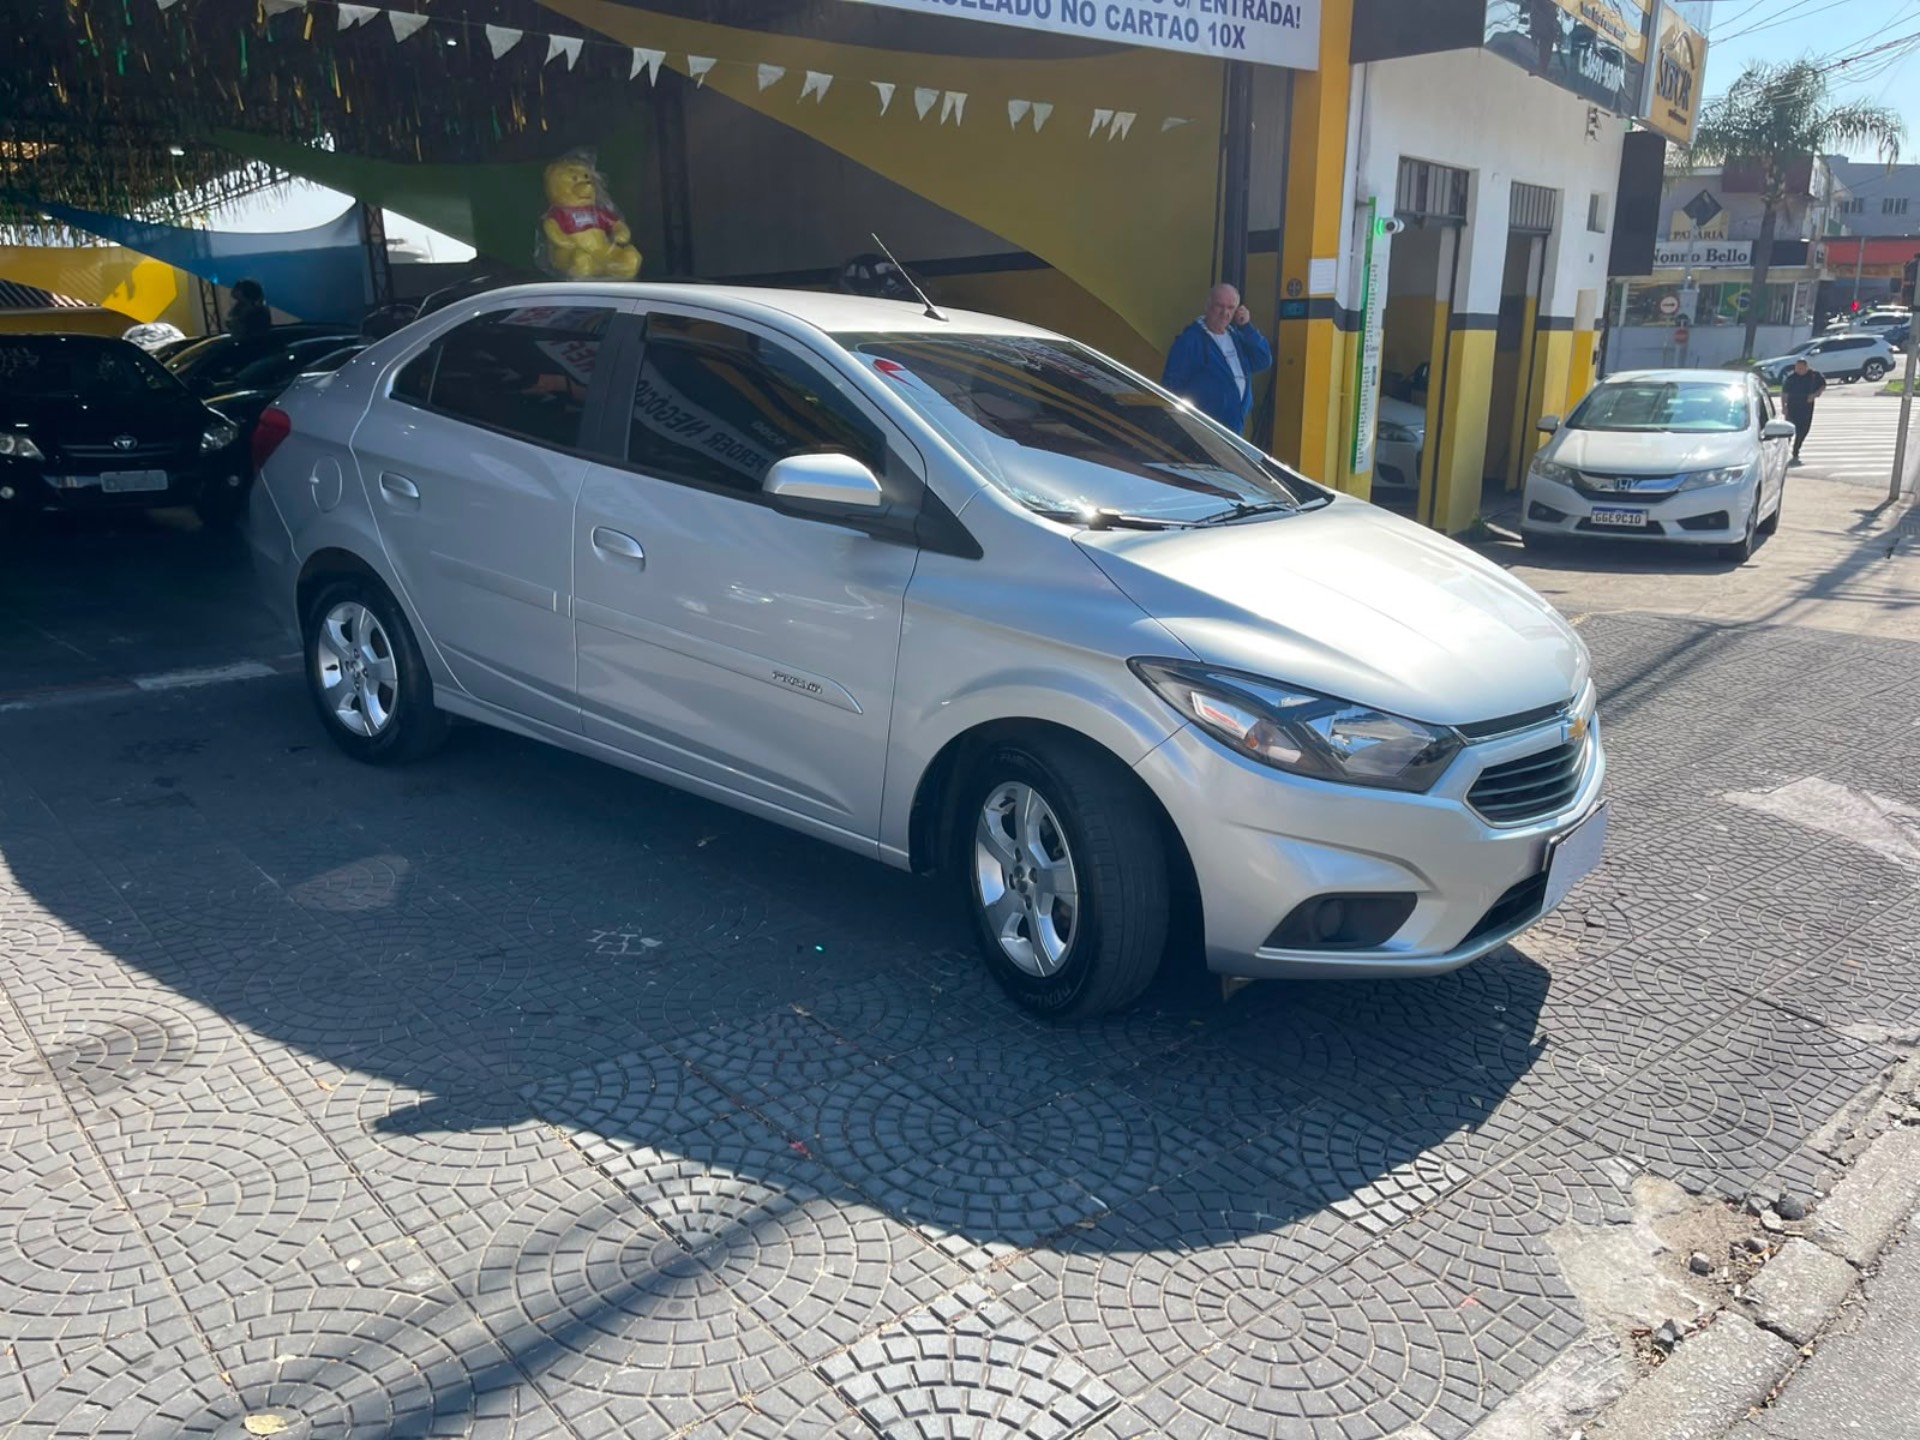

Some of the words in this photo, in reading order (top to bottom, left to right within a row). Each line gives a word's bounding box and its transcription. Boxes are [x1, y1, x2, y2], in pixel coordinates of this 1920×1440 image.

[1061, 0, 1096, 27] NO
[1207, 22, 1246, 49] 10X
[1200, 0, 1301, 28] ENTRADA!
[1706, 248, 1747, 263] Bello
[1596, 512, 1641, 524] GGE9C10
